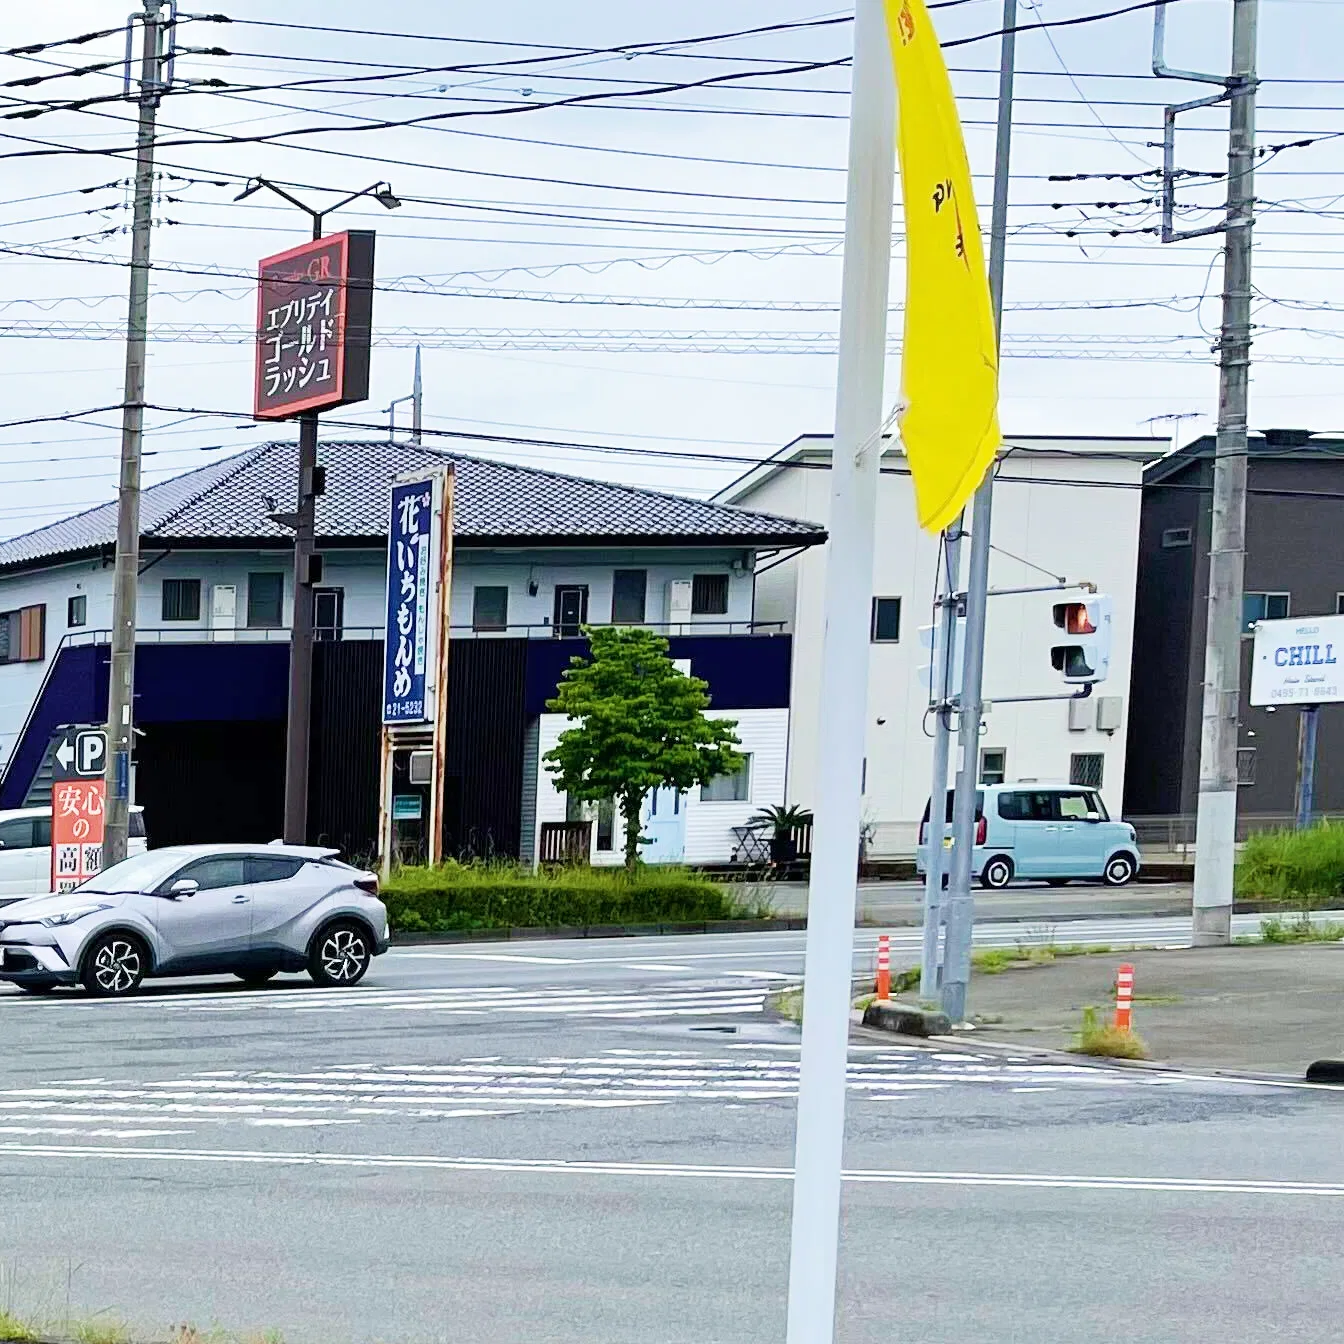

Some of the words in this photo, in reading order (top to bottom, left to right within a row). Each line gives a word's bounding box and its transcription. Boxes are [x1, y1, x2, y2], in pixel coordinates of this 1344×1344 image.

[265, 319, 334, 364] ゴールド
[265, 357, 331, 396] ラッシュ
[394, 494, 424, 698] 花いちもんめ
[1274, 644, 1337, 667] CHILL
[83, 736, 104, 770] P
[59, 785, 104, 817] 安心
[72, 818, 90, 839] の
